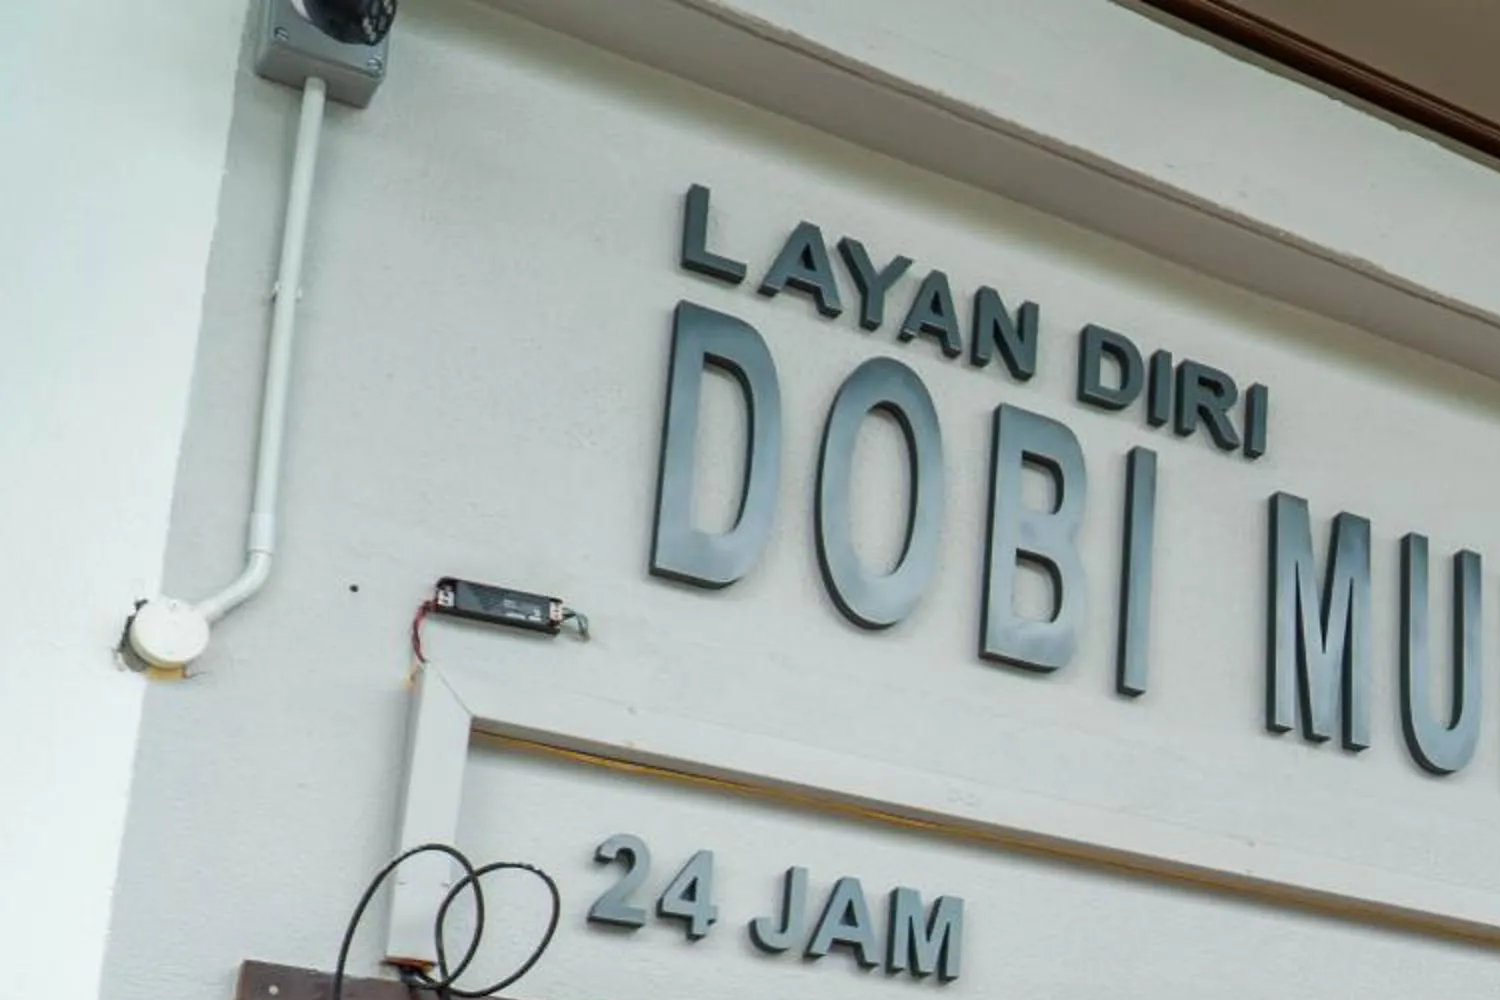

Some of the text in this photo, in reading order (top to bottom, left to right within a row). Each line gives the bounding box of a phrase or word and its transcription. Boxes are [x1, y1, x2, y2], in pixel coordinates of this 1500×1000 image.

[679, 184, 1268, 459] LAYAN DIRI
[649, 300, 1157, 697] DOBI
[586, 833, 965, 986] 24 JAM
